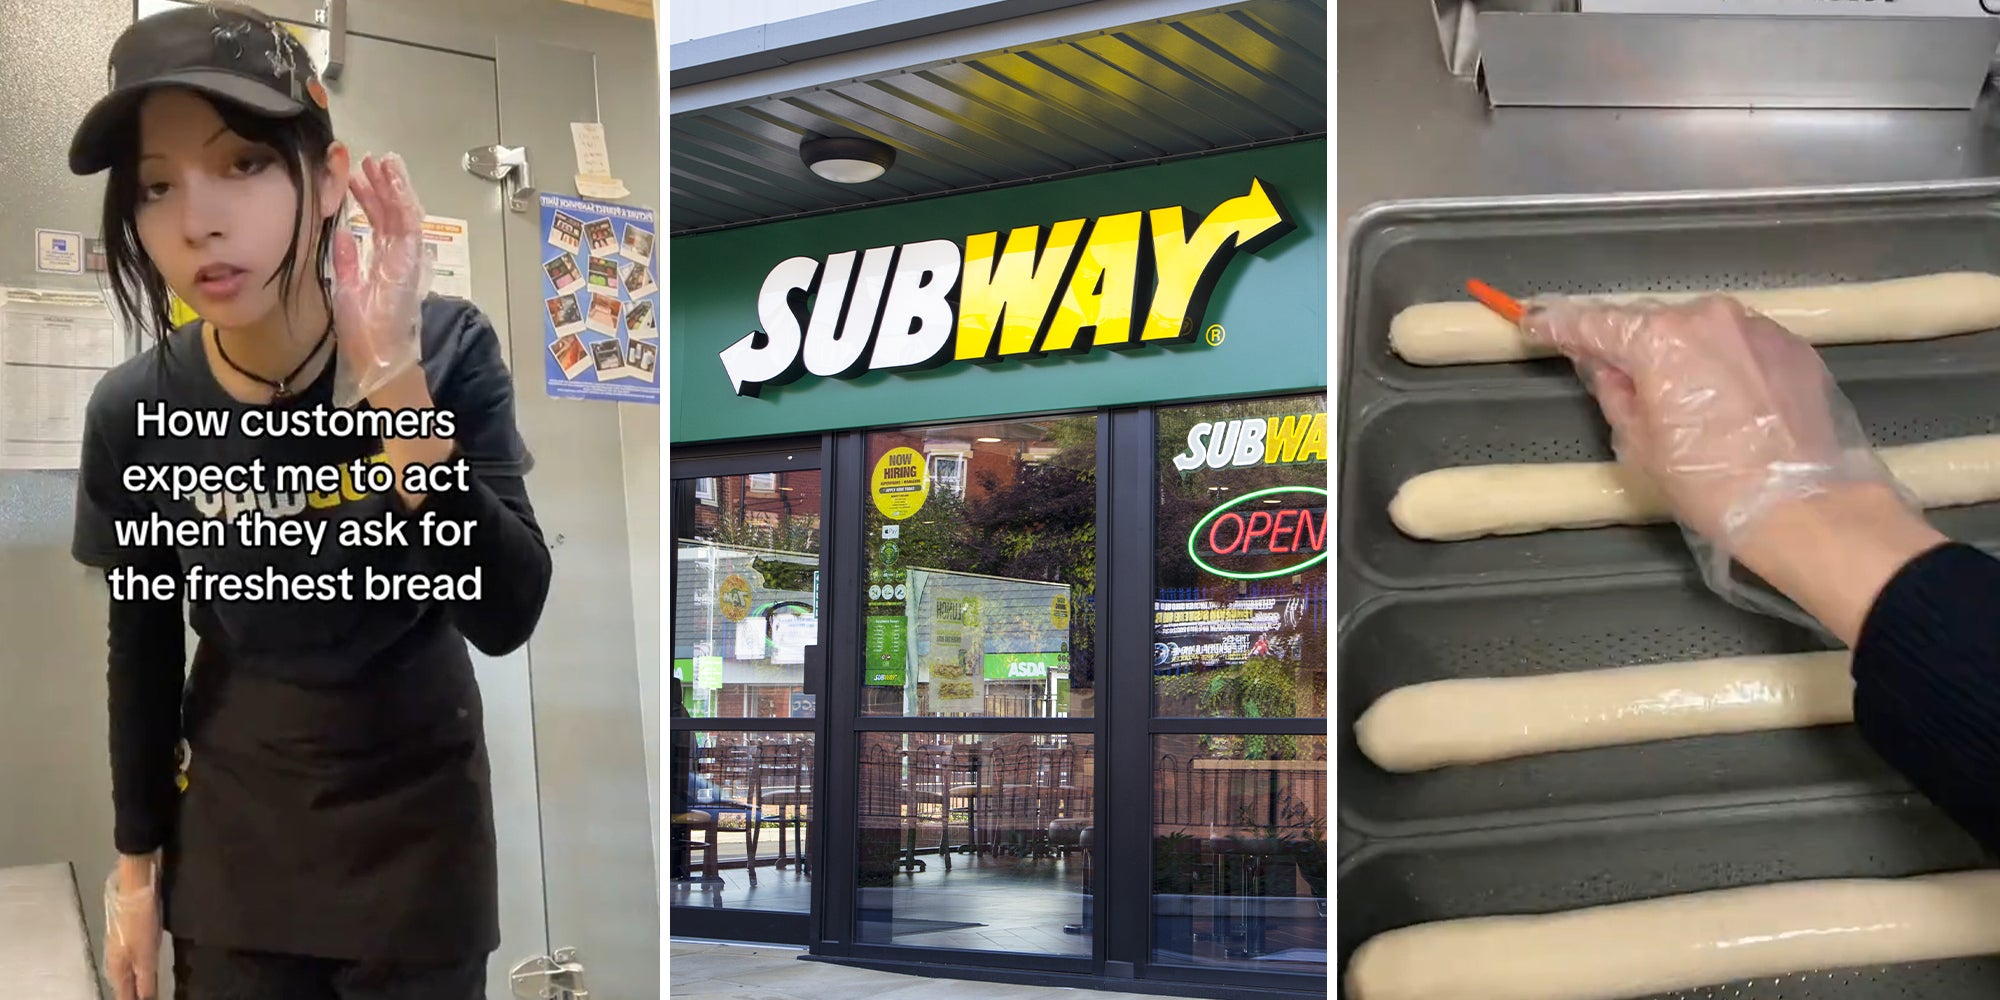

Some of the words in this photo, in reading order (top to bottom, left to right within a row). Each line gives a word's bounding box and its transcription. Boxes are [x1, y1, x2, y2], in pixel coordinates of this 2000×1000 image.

[718, 176, 1296, 396] SUBWAY
[1172, 413, 1328, 471] SUBWA
[884, 466, 915, 479] HIRING
[889, 454, 911, 466] NOW
[1209, 510, 1328, 554] OPEN
[1008, 661, 1047, 677] ASDA
